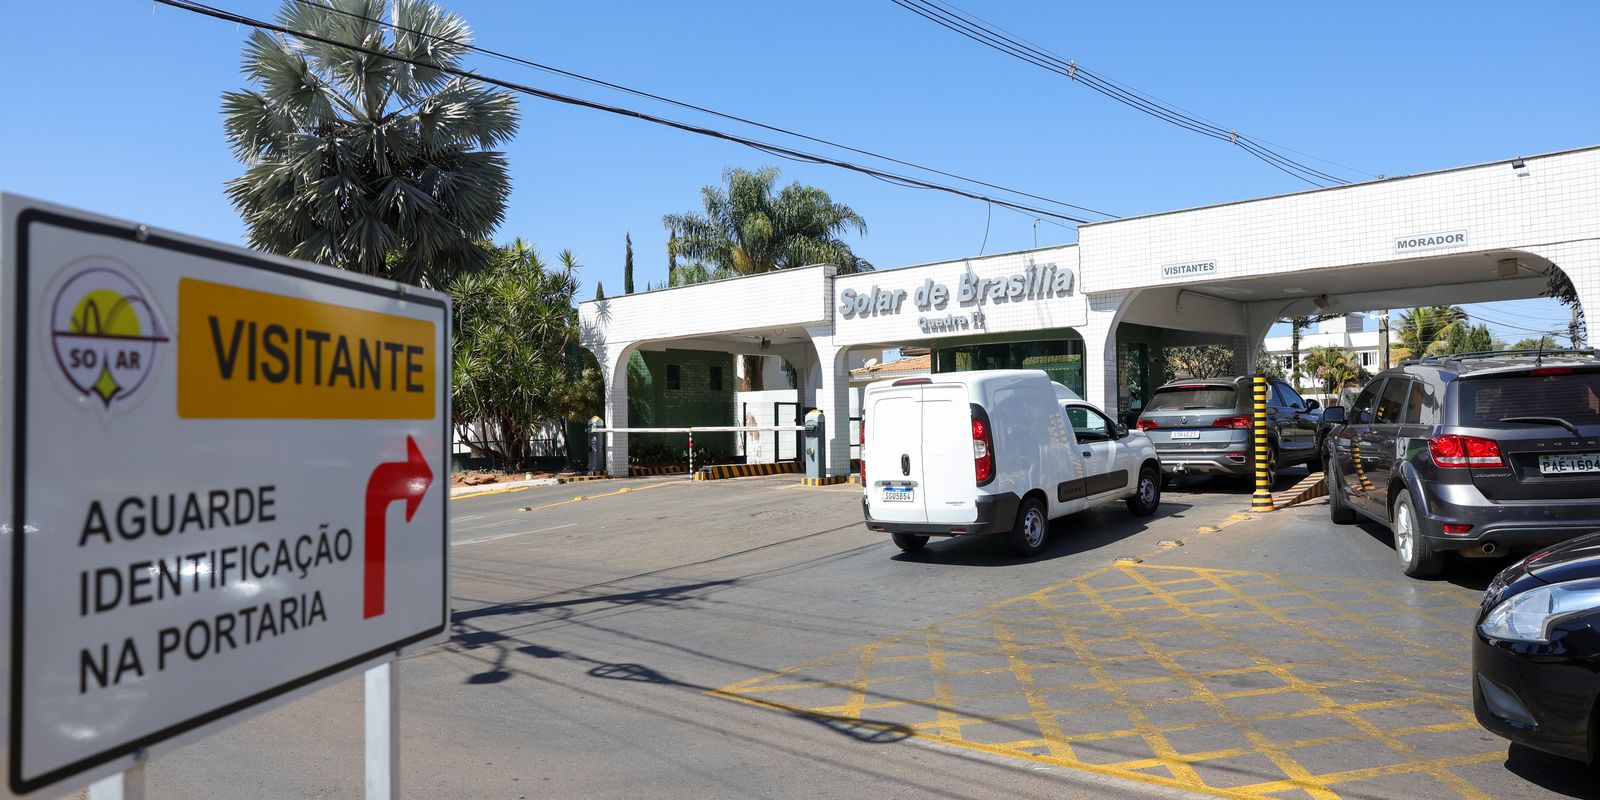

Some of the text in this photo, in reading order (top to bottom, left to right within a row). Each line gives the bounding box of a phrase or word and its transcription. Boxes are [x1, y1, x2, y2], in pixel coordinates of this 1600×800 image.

[1164, 262, 1215, 276] VISITANTES
[1397, 233, 1465, 249] MORADOR
[839, 263, 1075, 319] Solar de Brasília
[918, 314, 967, 334] Quadra
[208, 315, 425, 394] VISITANTE
[79, 485, 276, 547] AGUARDE
[80, 523, 352, 616] IDENTIFICAÇÃO
[79, 591, 327, 694] NA PORTARIA
